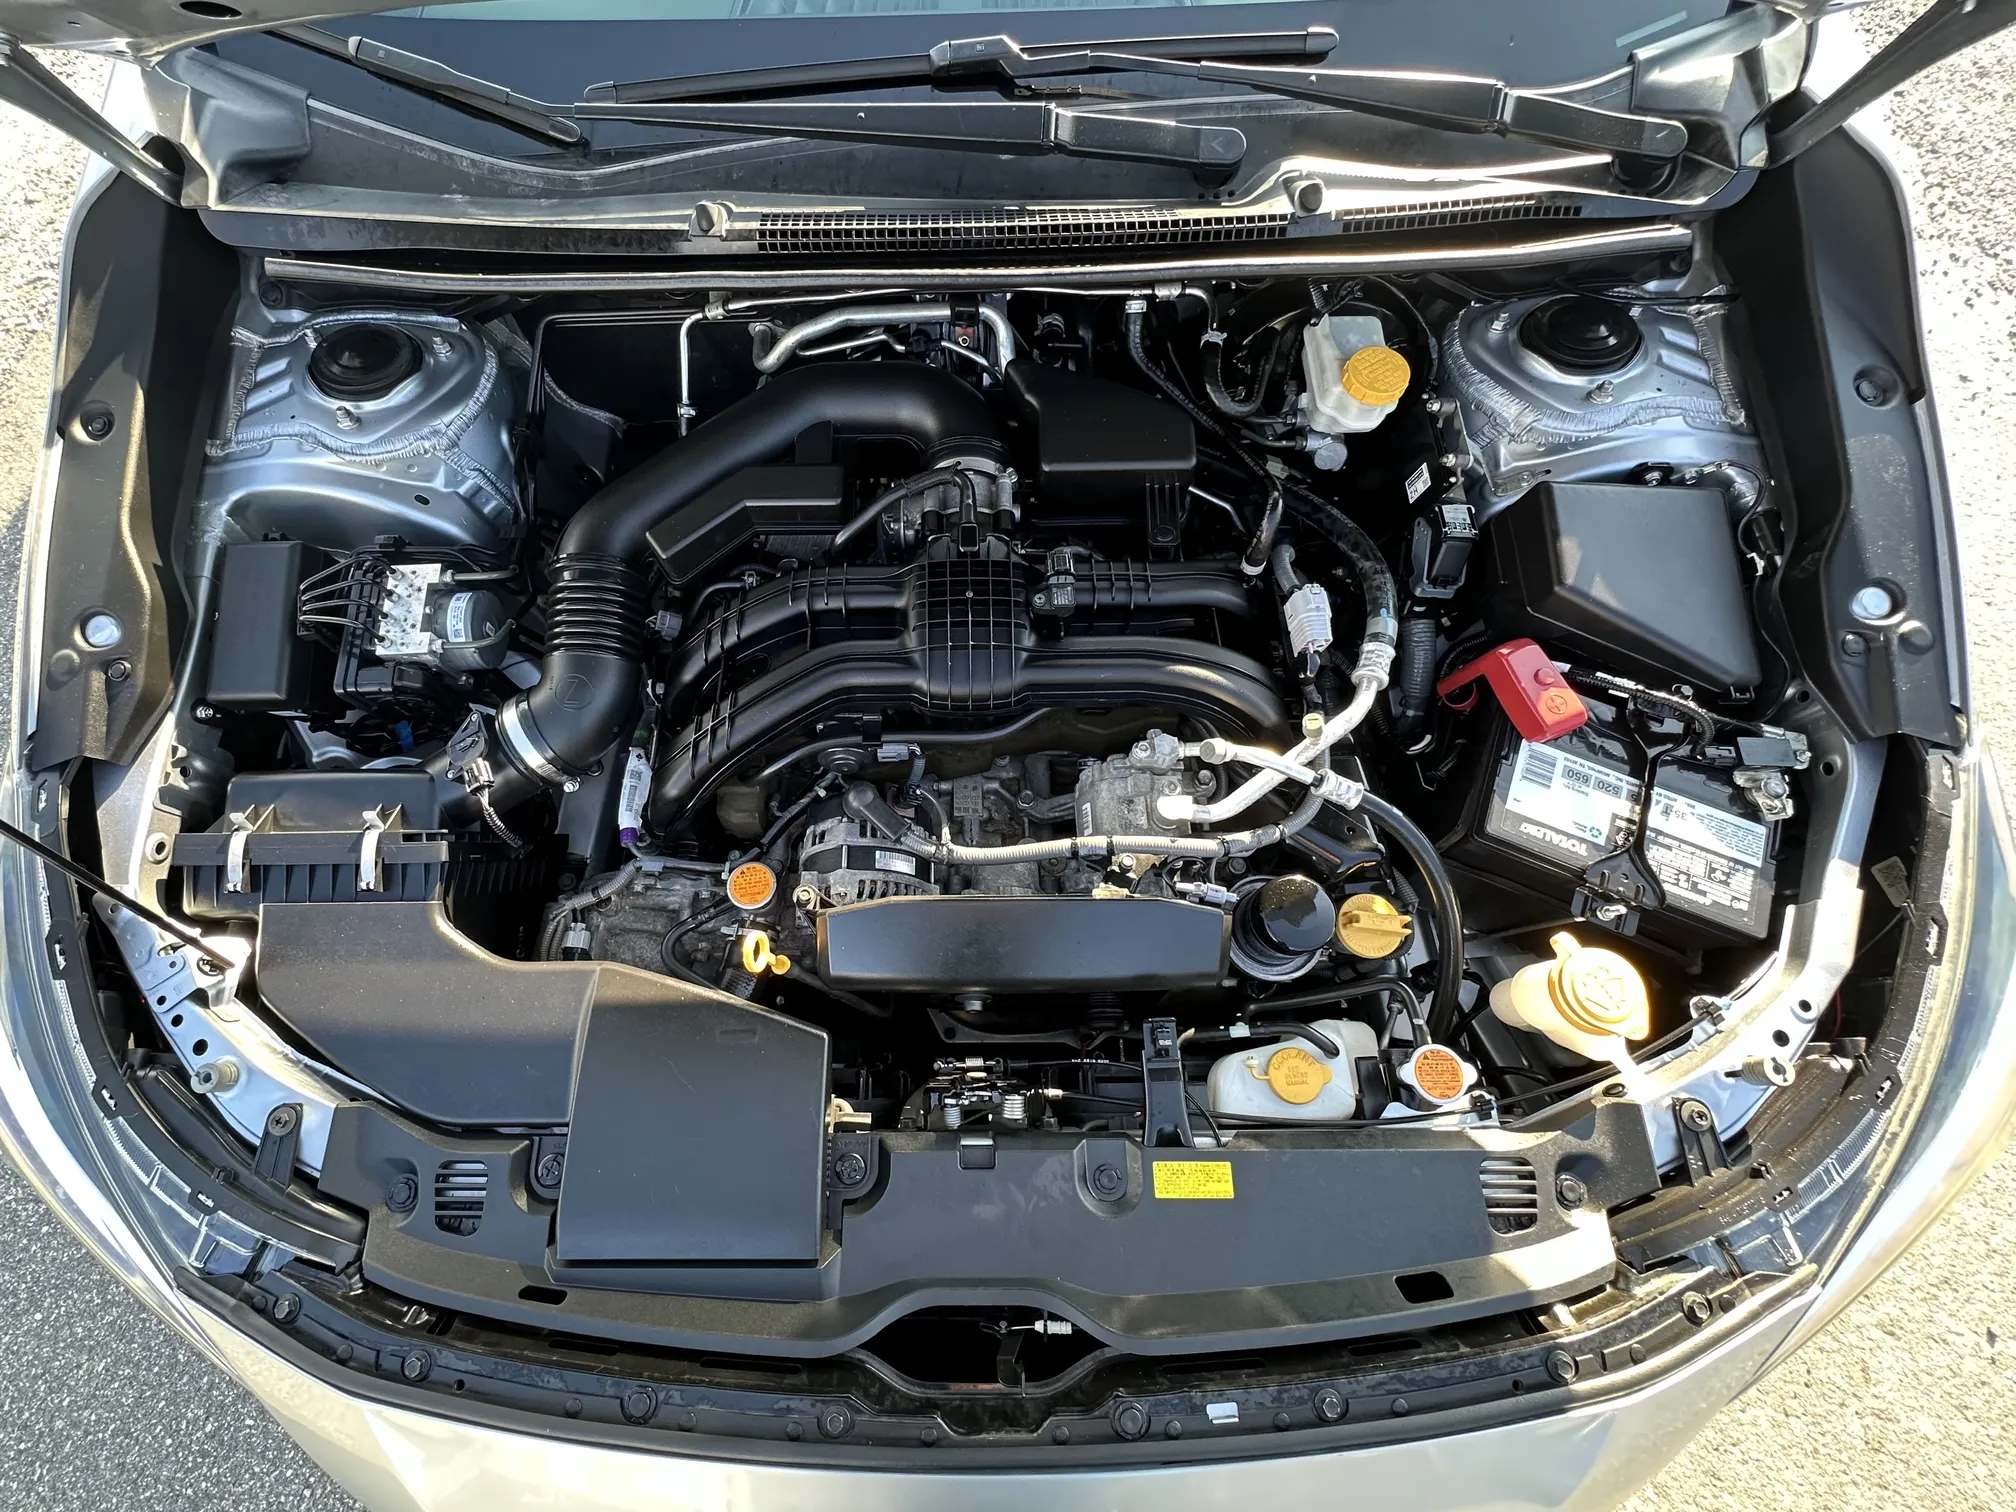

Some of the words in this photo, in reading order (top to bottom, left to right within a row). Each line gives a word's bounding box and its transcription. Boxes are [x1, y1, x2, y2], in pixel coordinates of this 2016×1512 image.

[1567, 768, 1590, 785] 650
[1597, 779, 1621, 797] 520
[1272, 1050, 1316, 1071] COOLANT
